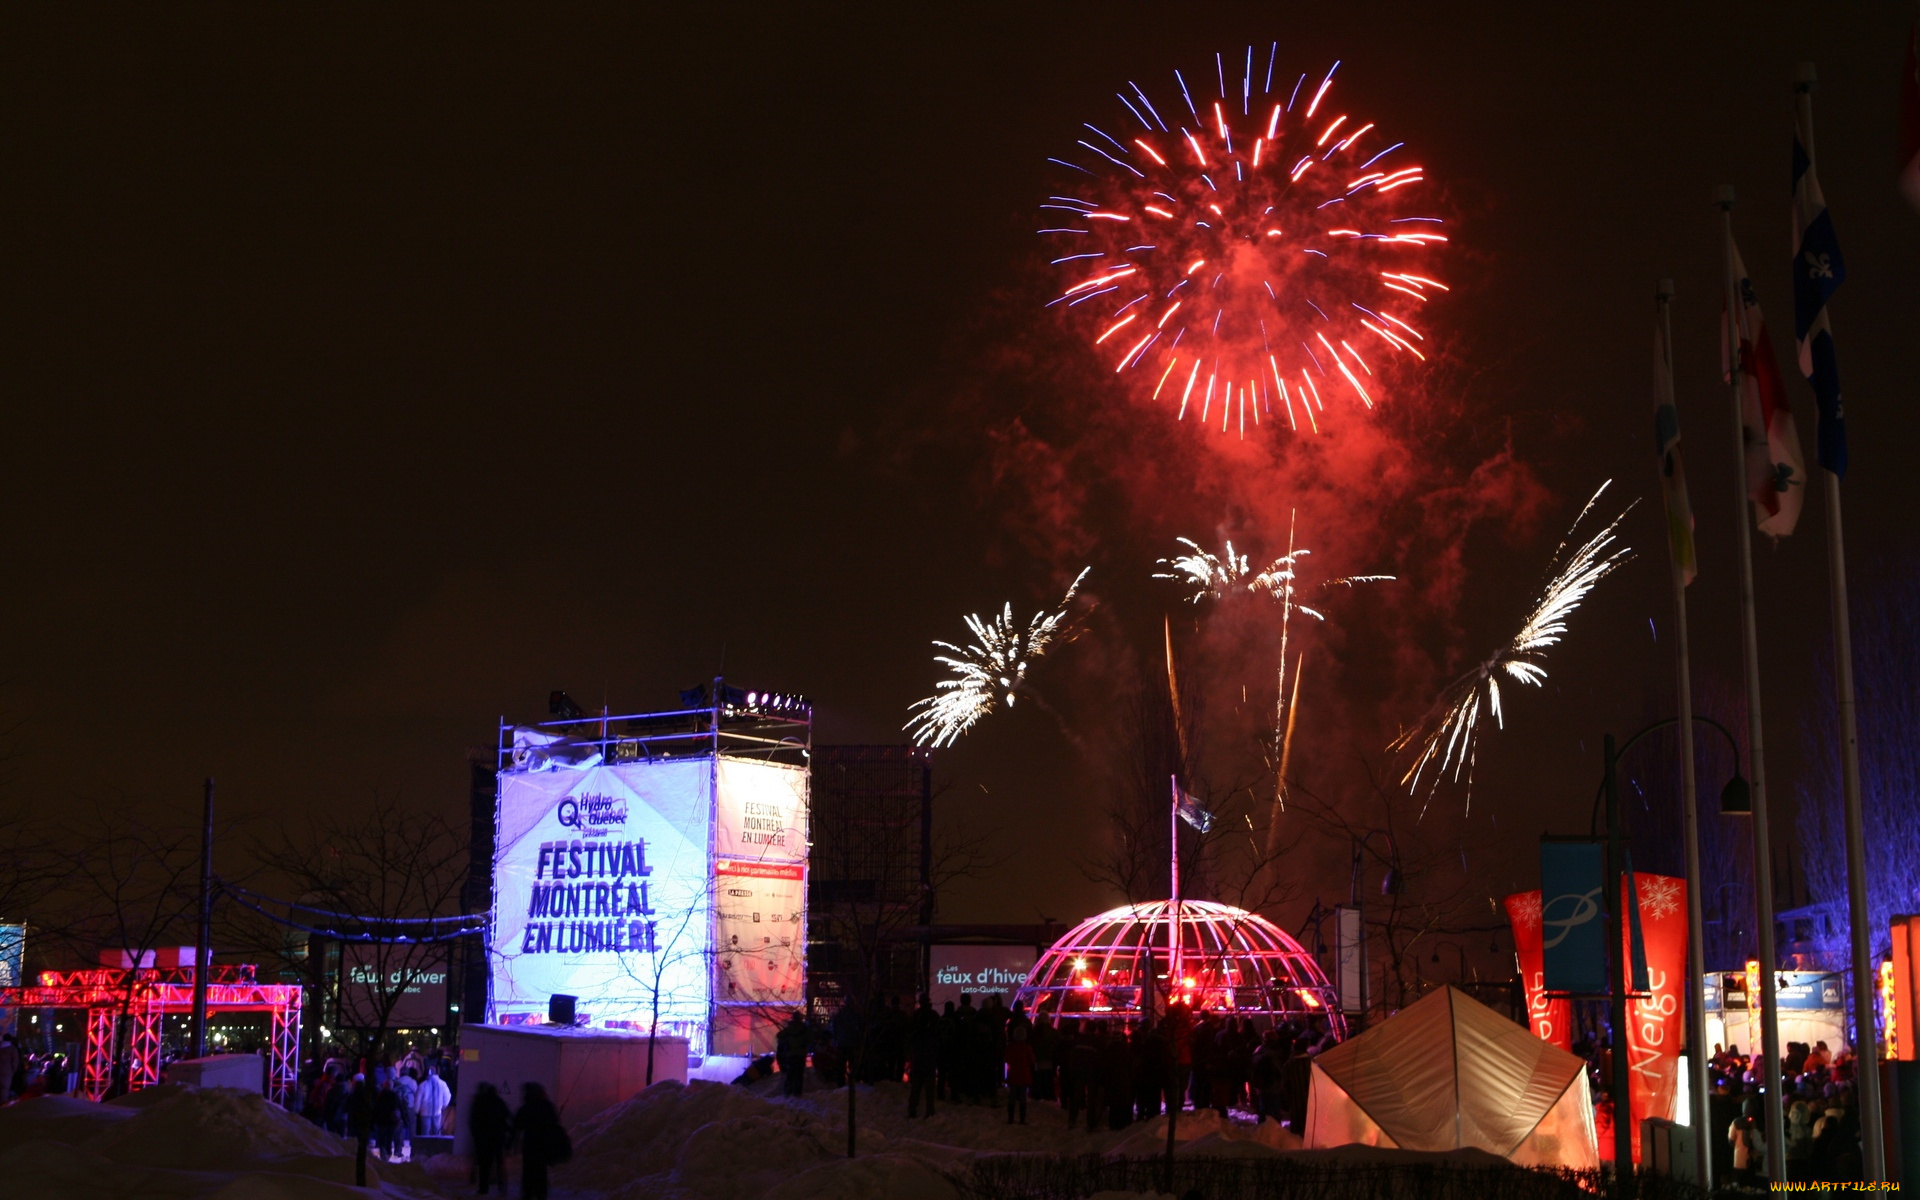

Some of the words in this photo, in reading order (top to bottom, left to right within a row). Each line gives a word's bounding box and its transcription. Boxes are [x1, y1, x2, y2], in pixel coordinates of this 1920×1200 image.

[745, 802, 783, 818] FESTIVAL
[742, 831, 752, 843] EN
[536, 839, 653, 880] FESTIVAL
[529, 880, 655, 918] MONTRÉAL
[522, 921, 553, 954] EN
[937, 970, 972, 984] feux
[976, 968, 1028, 984] d'hive
[961, 986, 1009, 994] Loto-Québec
[1631, 966, 1677, 1078] Neige
